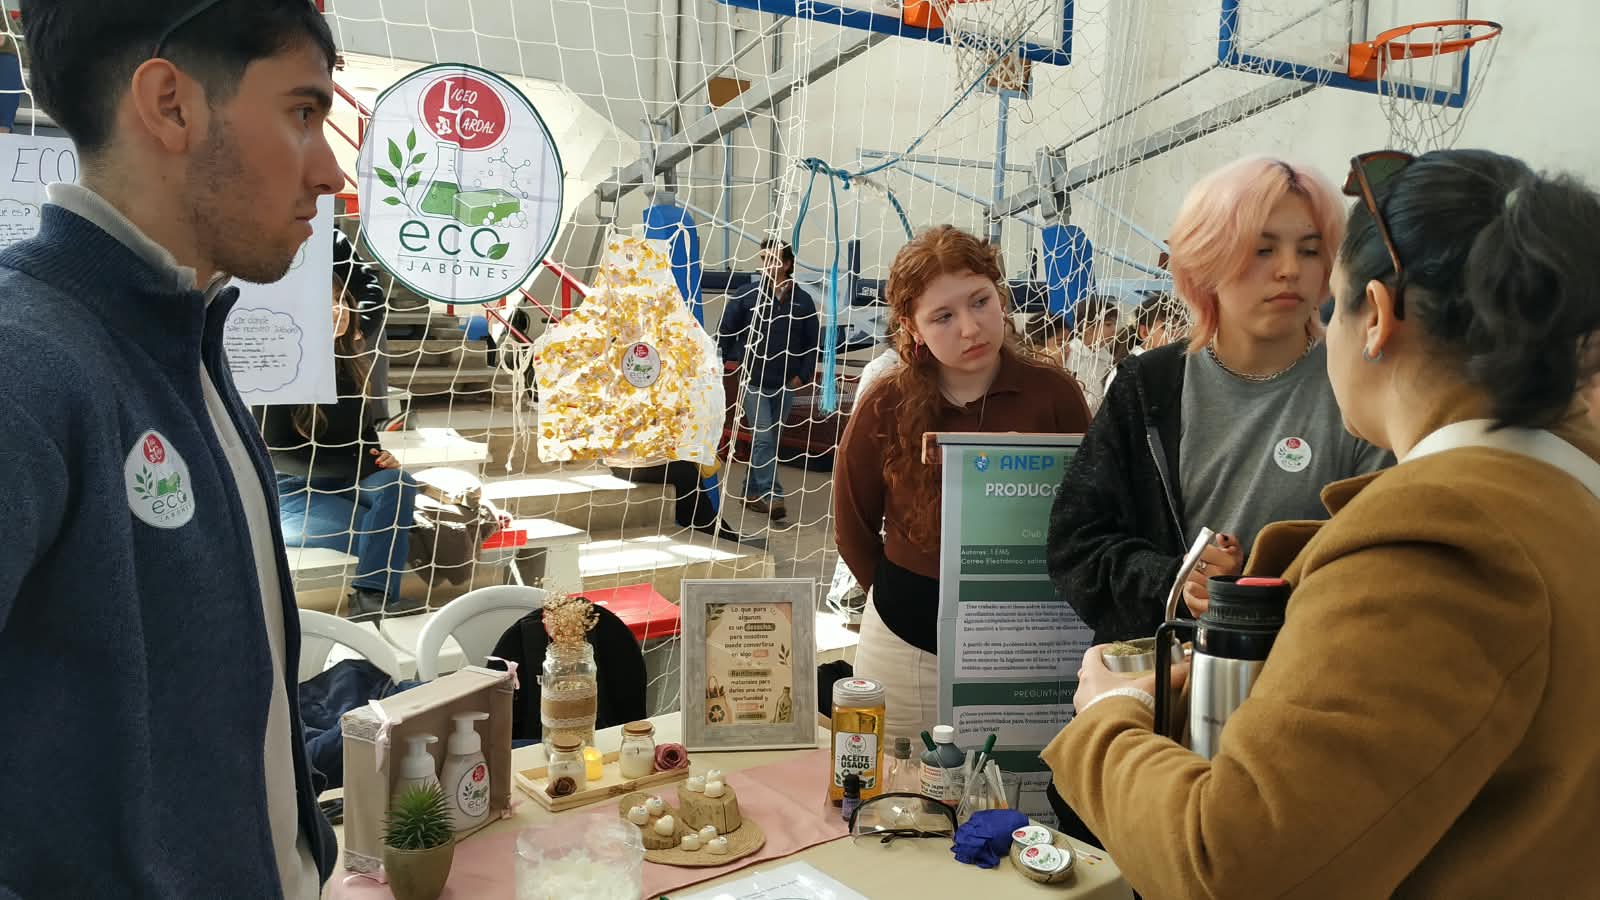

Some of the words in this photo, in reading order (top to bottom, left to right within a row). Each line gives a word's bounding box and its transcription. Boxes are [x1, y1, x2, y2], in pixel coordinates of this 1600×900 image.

[12, 147, 76, 185] ECO
[398, 219, 502, 258] eco
[407, 260, 509, 280] JABONES
[1000, 455, 1055, 471] ANEP
[152, 489, 186, 514] eco
[1022, 529, 1041, 538] Club
[1013, 690, 1057, 698] PREGUNTA
[841, 754, 869, 763] ACEITE
[841, 762, 870, 770] USADO
